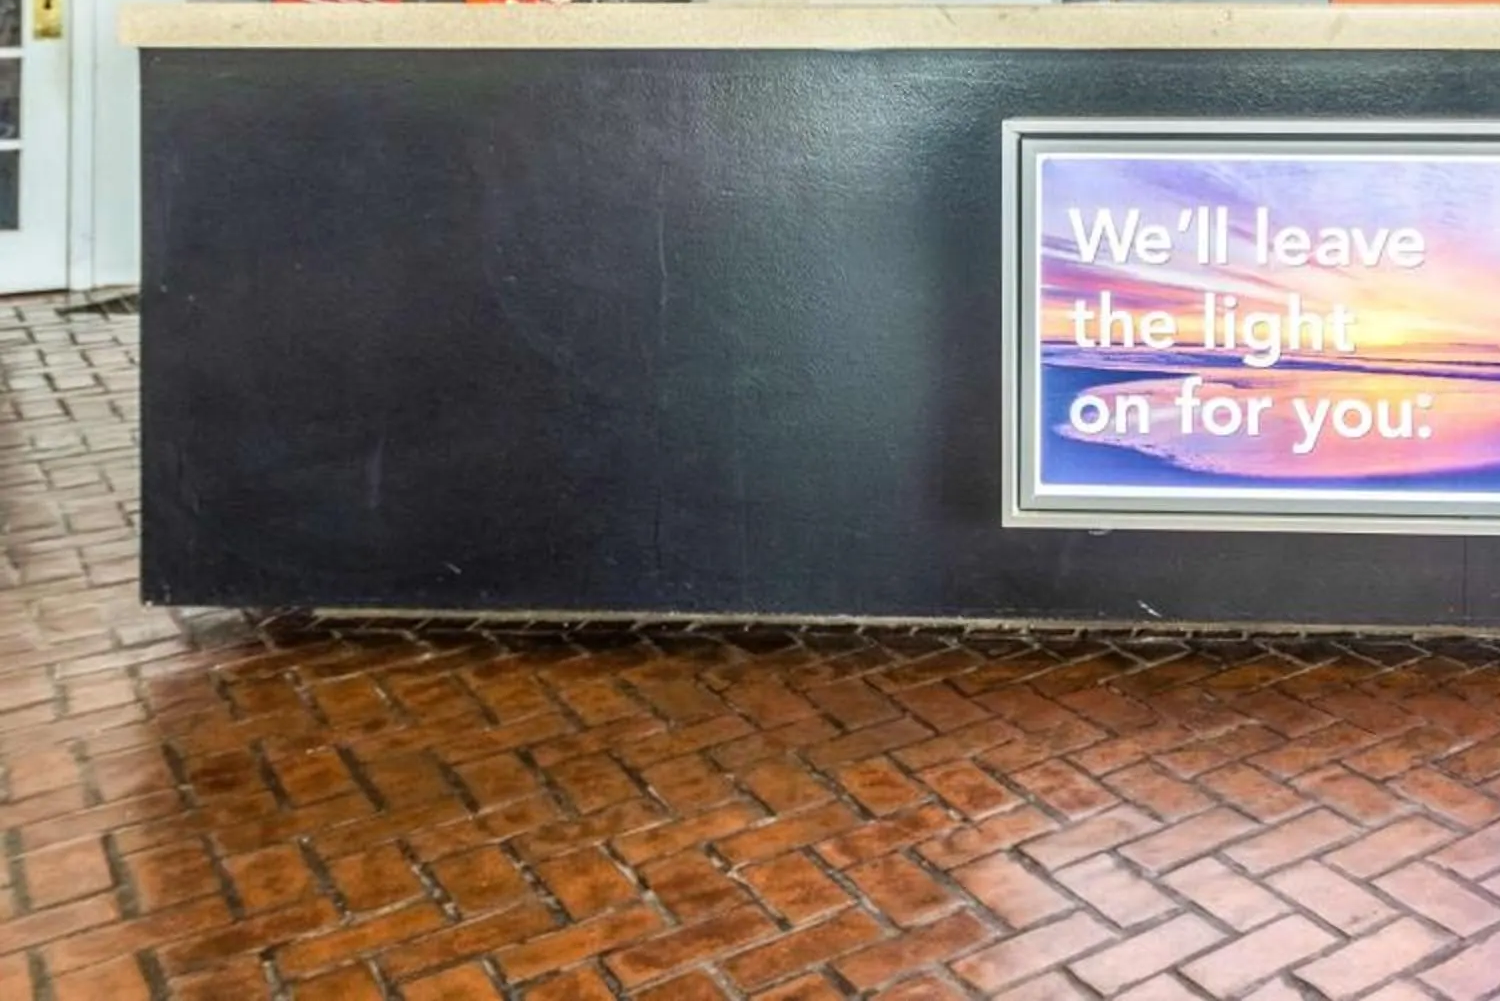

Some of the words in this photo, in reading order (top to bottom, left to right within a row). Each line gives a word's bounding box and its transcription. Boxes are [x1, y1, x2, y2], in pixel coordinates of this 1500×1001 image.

[1068, 206, 1229, 266] We'll
[1256, 206, 1426, 268] leave
[1069, 291, 1178, 350] the
[1203, 292, 1357, 368] light
[1068, 394, 1151, 435] on
[1174, 376, 1273, 437] for
